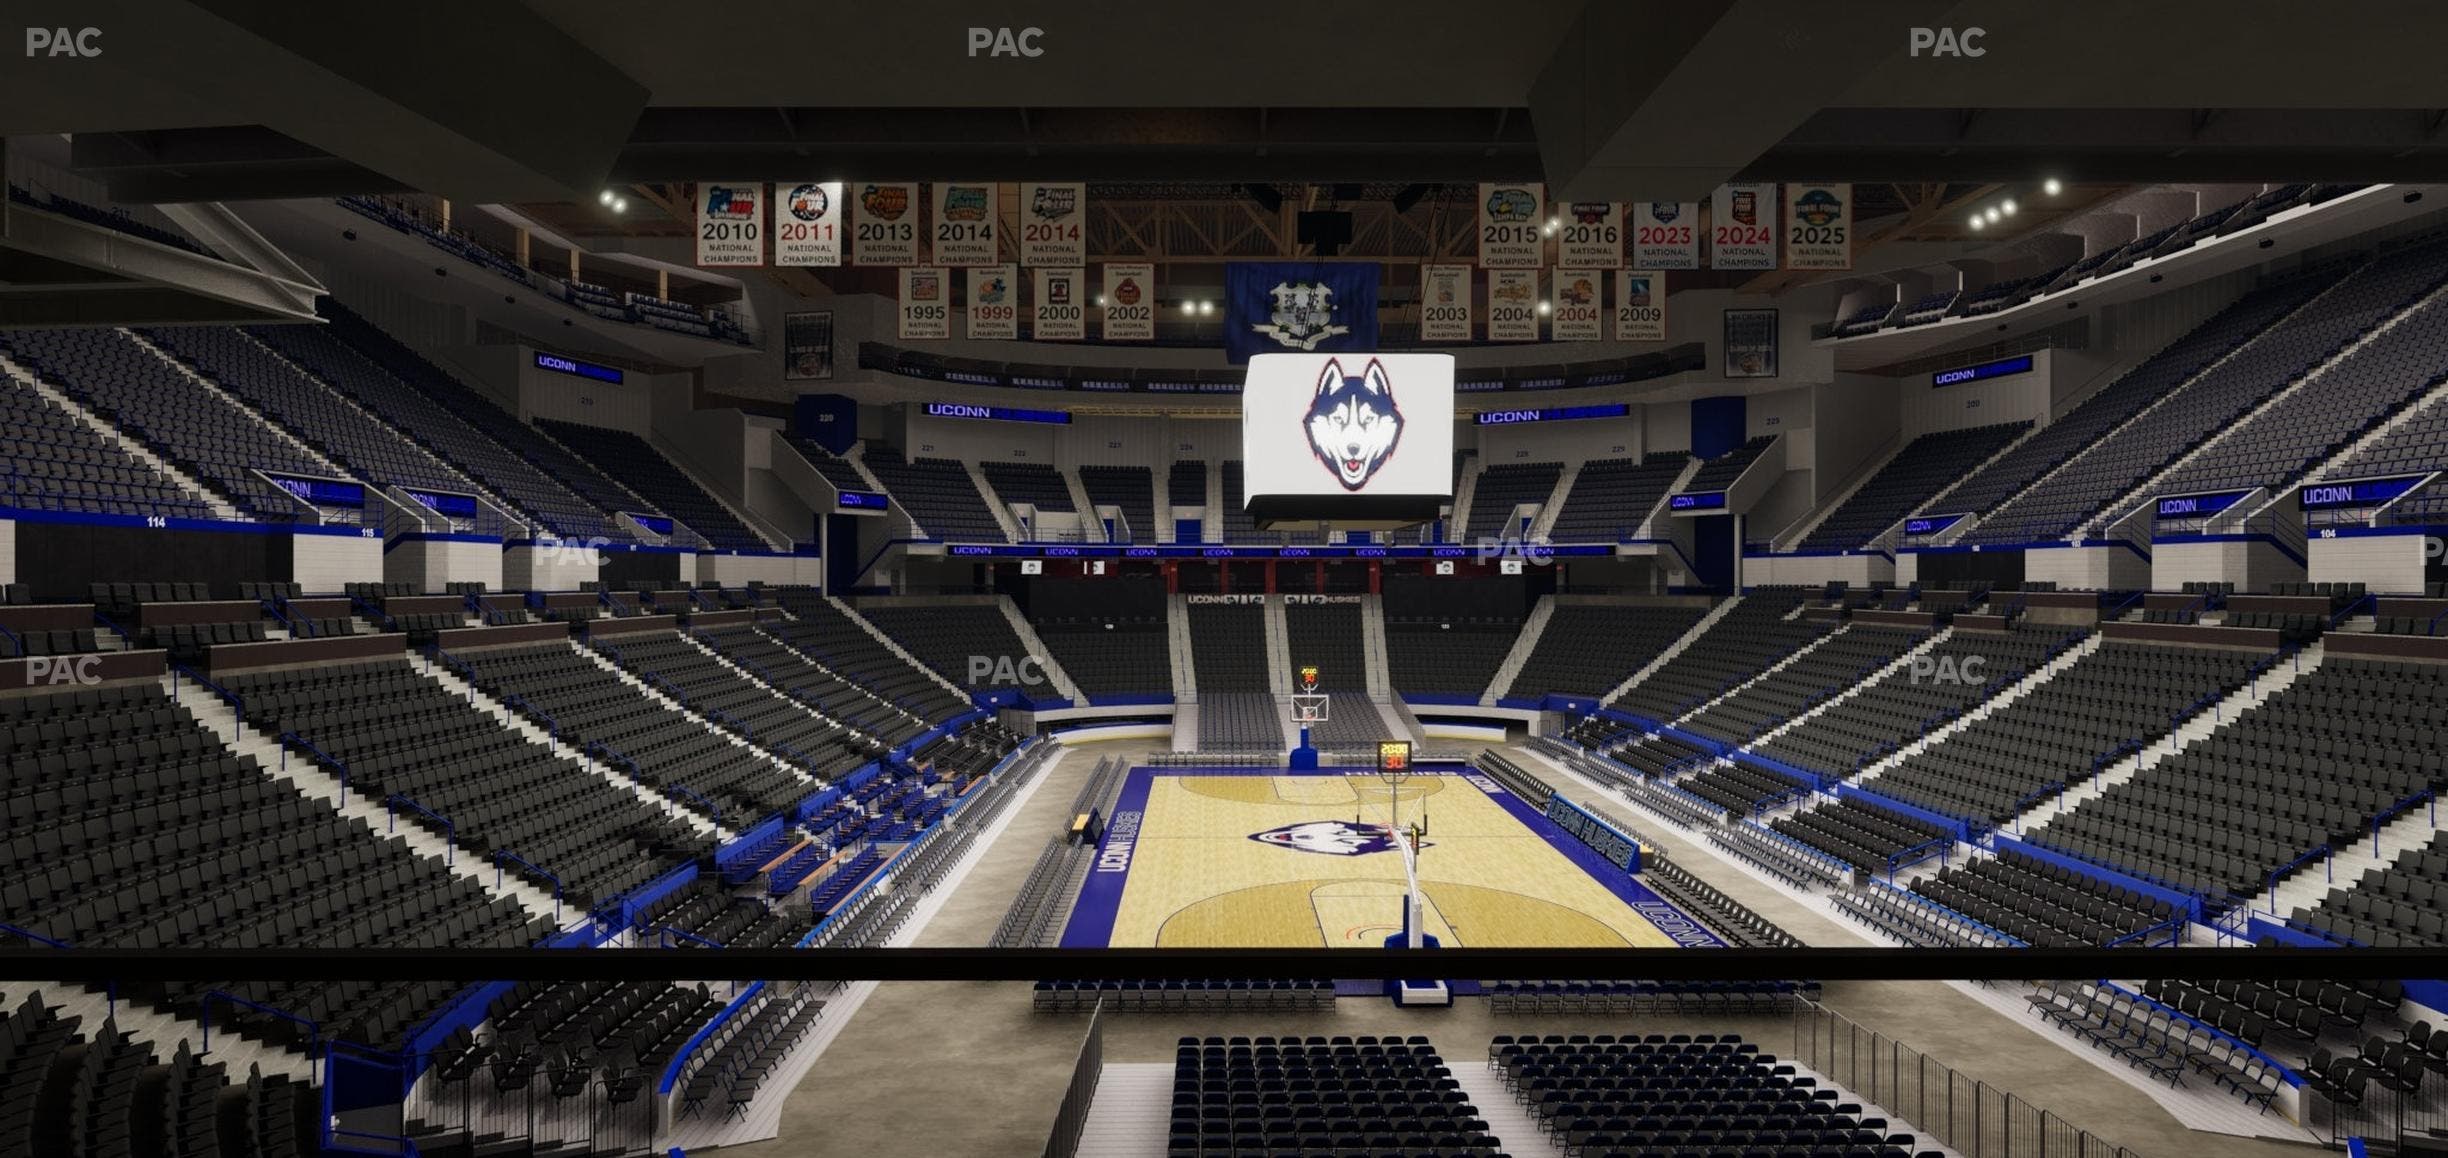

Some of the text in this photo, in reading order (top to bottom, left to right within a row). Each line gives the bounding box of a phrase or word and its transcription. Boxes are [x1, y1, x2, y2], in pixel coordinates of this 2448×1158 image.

[703, 223, 757, 240] 2010
[781, 223, 833, 240] 2011
[859, 224, 912, 241] 2013
[938, 224, 992, 241] 2014
[1025, 224, 1080, 241] 2014
[1484, 226, 1538, 243] 2015
[1564, 226, 1617, 243] 2016
[1639, 227, 1691, 244] 2023
[1716, 227, 1770, 244] 2024
[1791, 228, 1844, 244] 2025
[1032, 245, 1076, 253] NATIONAL
[1722, 248, 1765, 256] NATIONAL
[1027, 256, 1080, 264] CHAMPIONS
[1565, 258, 1618, 266] CHAMPIONS
[1719, 259, 1769, 267] CHAMPIONS
[1793, 259, 1845, 267] CHAMPIONS
[904, 306, 945, 320] 1995
[972, 306, 1013, 320] 1999
[1038, 306, 1080, 320] 2000
[1108, 306, 1150, 320] 2002
[1425, 308, 1467, 321] 2003
[1492, 308, 1534, 321] 2004
[1556, 308, 1598, 321] 2004
[1619, 308, 1661, 321] 2009
[539, 355, 576, 372] UCONN
[1936, 369, 1975, 384] UCONN
[929, 403, 990, 419] UCONN
[1480, 410, 1540, 424] UCONN
[2303, 486, 2352, 504] UCONN
[2159, 498, 2197, 514] UCONN
[146, 516, 166, 529] 114
[1906, 521, 1931, 532] UCONN
[2320, 528, 2336, 538] 104
[954, 547, 991, 556] UCONN
[1045, 547, 1079, 556] UCONN
[1125, 547, 1157, 556] UCONN
[1203, 547, 1233, 556] UCONN
[1279, 547, 1310, 556] UCONN
[1355, 547, 1386, 556] UCONN
[1433, 547, 1465, 556] UCONN
[1188, 594, 1225, 604] UCONN
[1549, 798, 1633, 870] UCONN HUSKIES
[1096, 811, 1142, 872] HUSKIES UCONN
